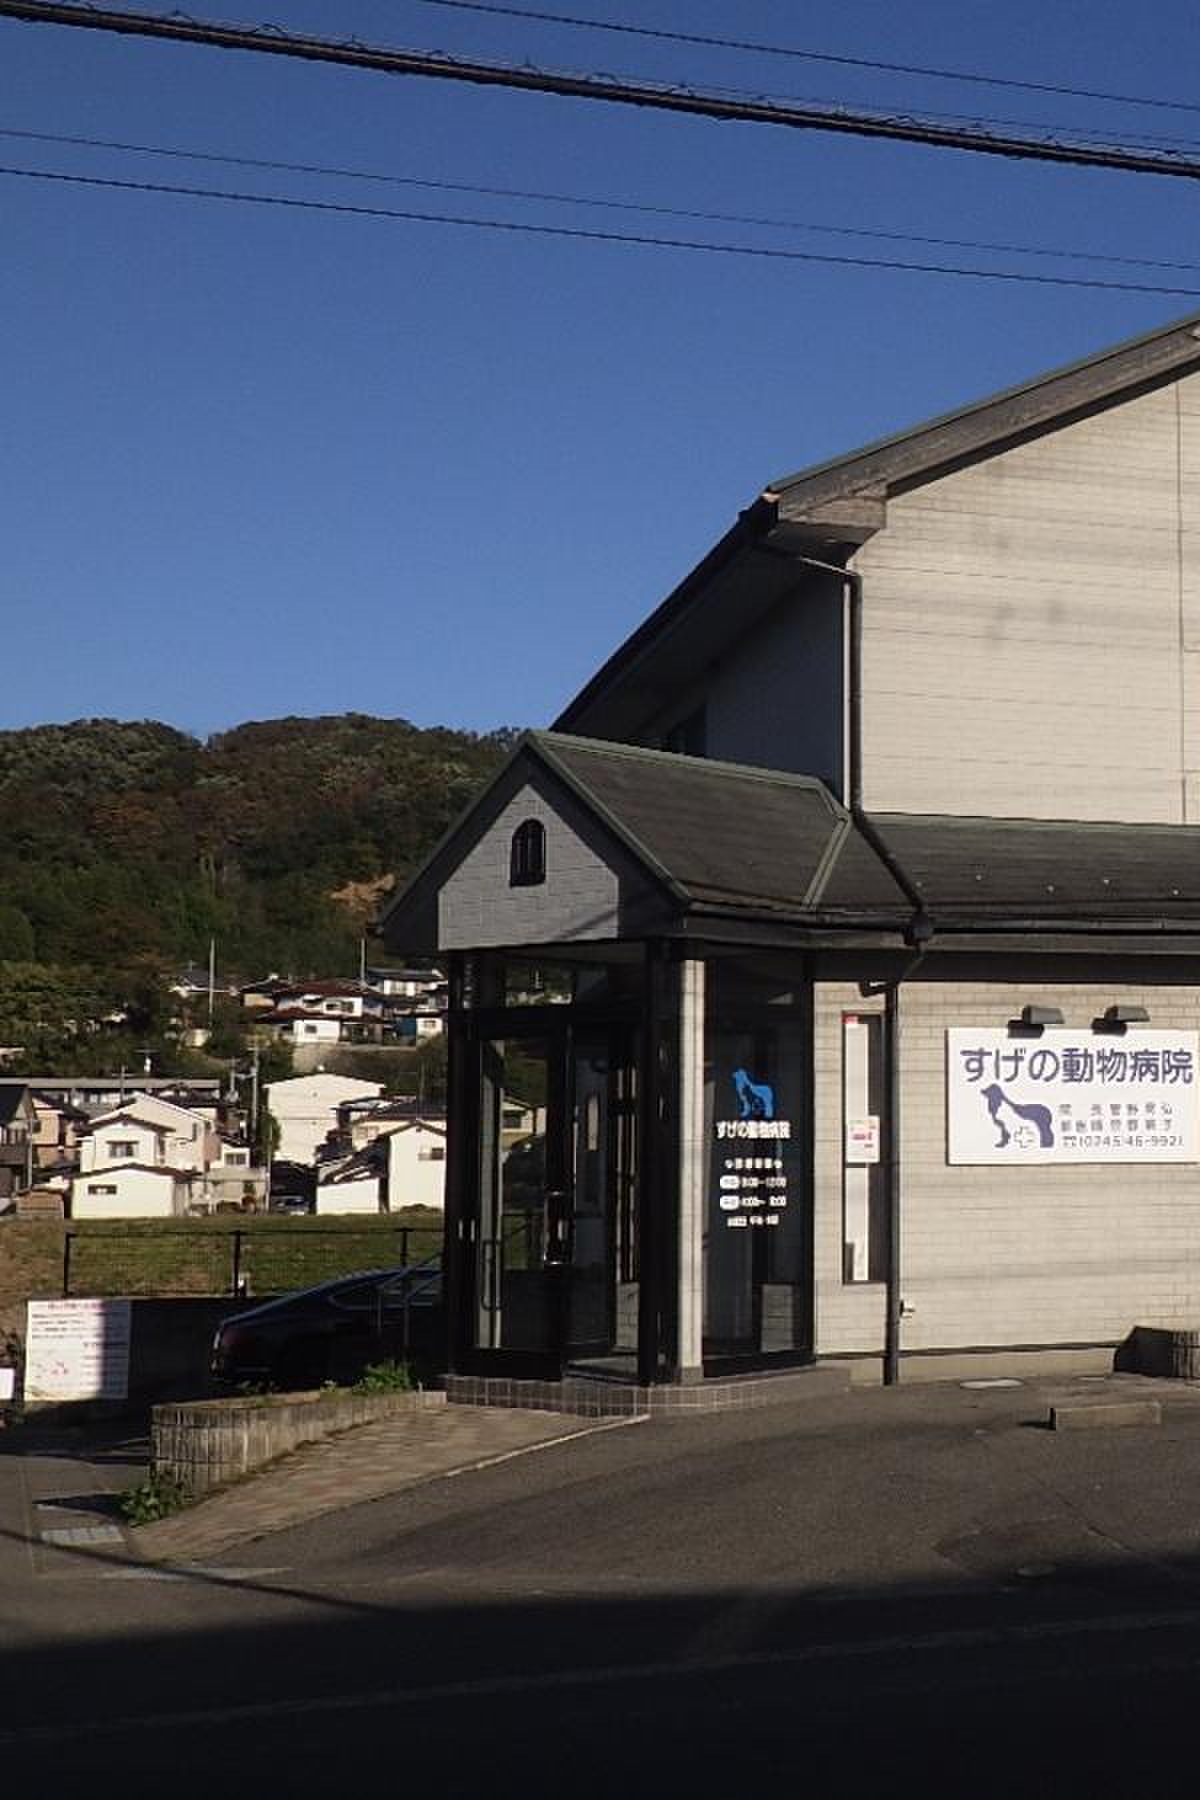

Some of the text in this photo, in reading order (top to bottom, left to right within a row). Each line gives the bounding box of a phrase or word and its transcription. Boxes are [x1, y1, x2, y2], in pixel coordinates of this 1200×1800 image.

[960, 1048, 1193, 1084] すげの動物病院
